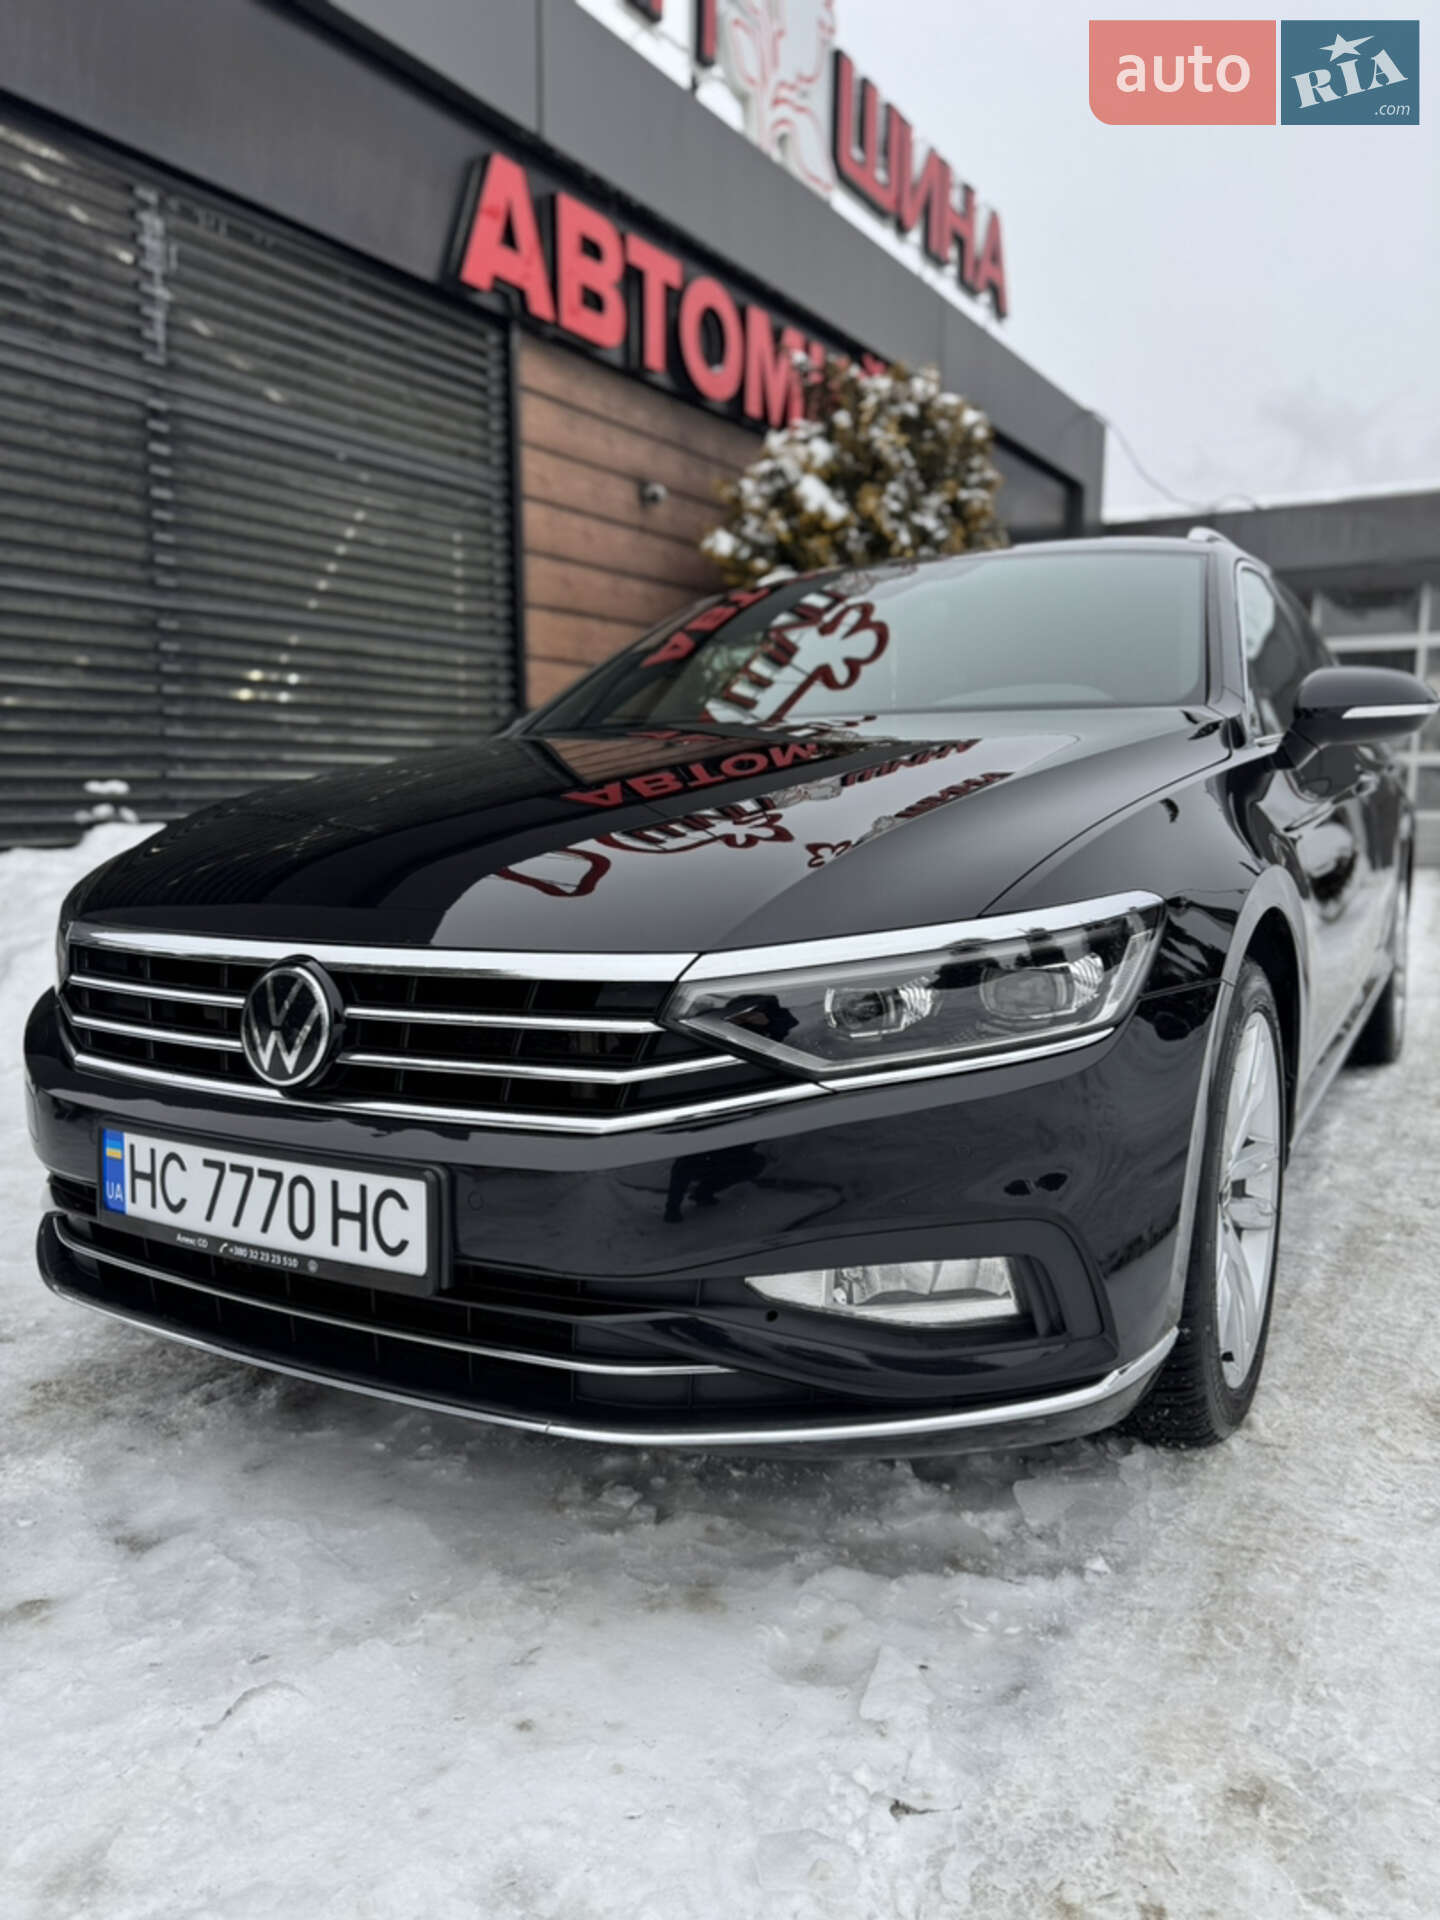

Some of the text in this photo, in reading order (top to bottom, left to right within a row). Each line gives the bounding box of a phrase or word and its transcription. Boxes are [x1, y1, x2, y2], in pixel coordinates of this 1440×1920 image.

[834, 48, 1008, 321] ШИНА
[456, 151, 888, 431] АВТОМ
[106, 1182, 124, 1202] UA
[129, 1143, 409, 1257] HC 7770 HC
